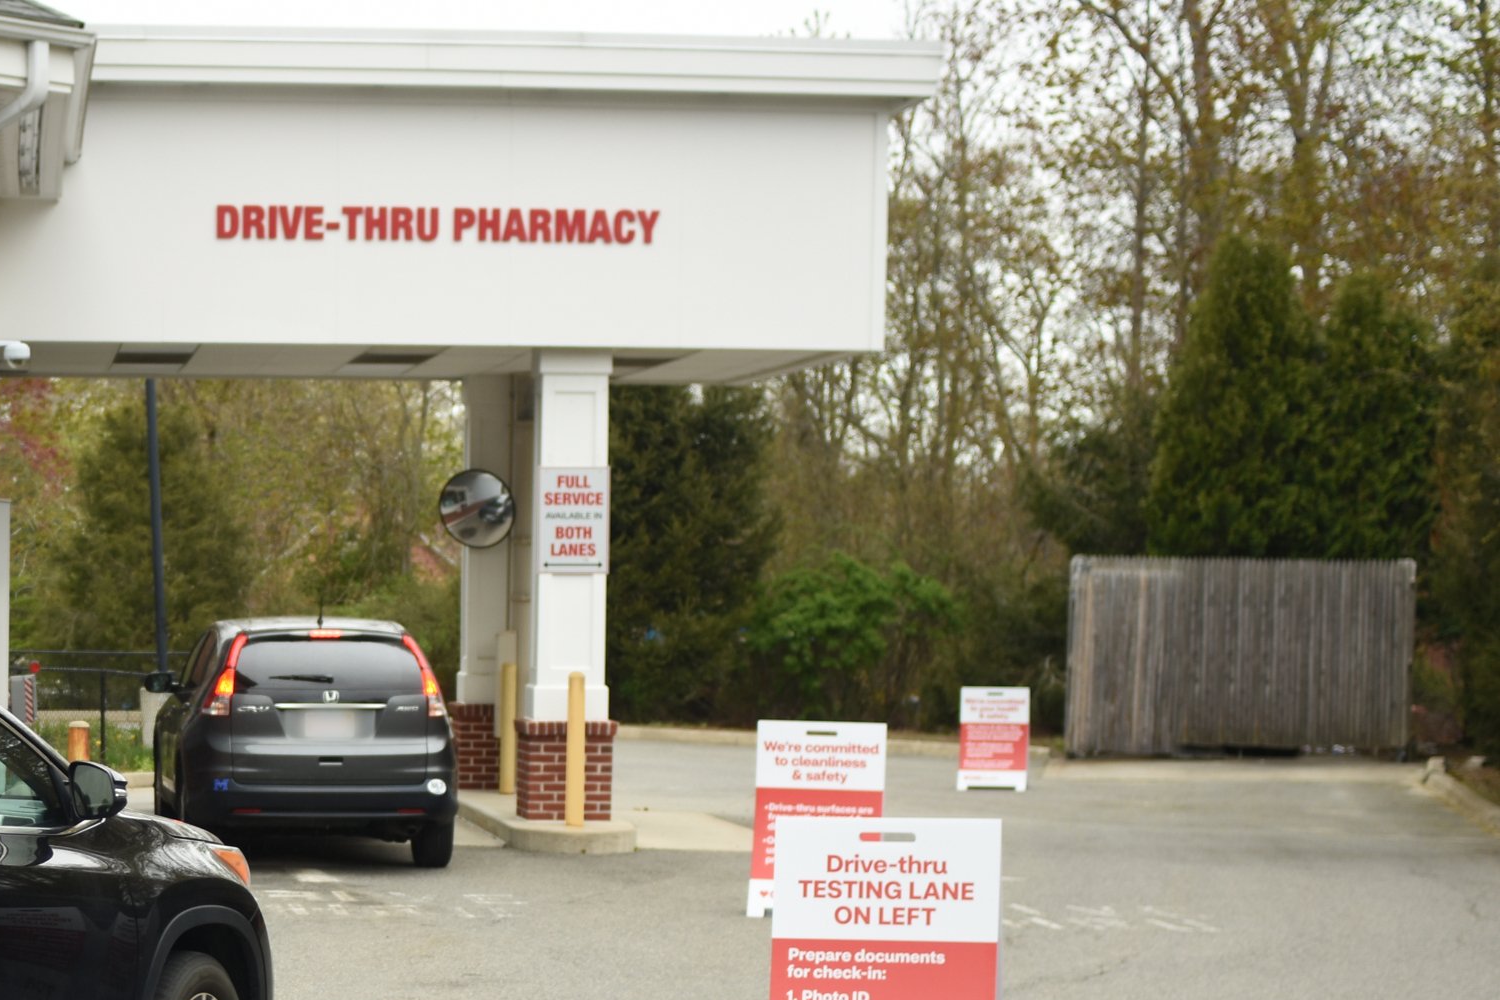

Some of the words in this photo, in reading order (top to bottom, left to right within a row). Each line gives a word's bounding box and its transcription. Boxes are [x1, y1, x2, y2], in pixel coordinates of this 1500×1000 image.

[215, 205, 439, 242] DRIVE-THRU
[453, 208, 660, 245] PHARMACY
[557, 475, 591, 488] FULL
[544, 492, 603, 505] SERVICE
[555, 526, 592, 539] BOTH
[550, 543, 596, 556] LANES
[763, 741, 801, 752] We're
[805, 743, 880, 754] committed
[775, 756, 788, 766] to
[791, 756, 867, 768] cleanliness
[792, 770, 801, 780] &
[806, 770, 848, 784] safety
[827, 854, 948, 874] Drive-thru
[799, 879, 902, 900] TESTING
[909, 881, 974, 900] LANE
[834, 904, 870, 925] ON
[878, 906, 936, 926] LEFT
[788, 946, 852, 964] Prepare
[854, 947, 946, 964] documents
[787, 964, 811, 978] for
[813, 965, 886, 980] check-in:
